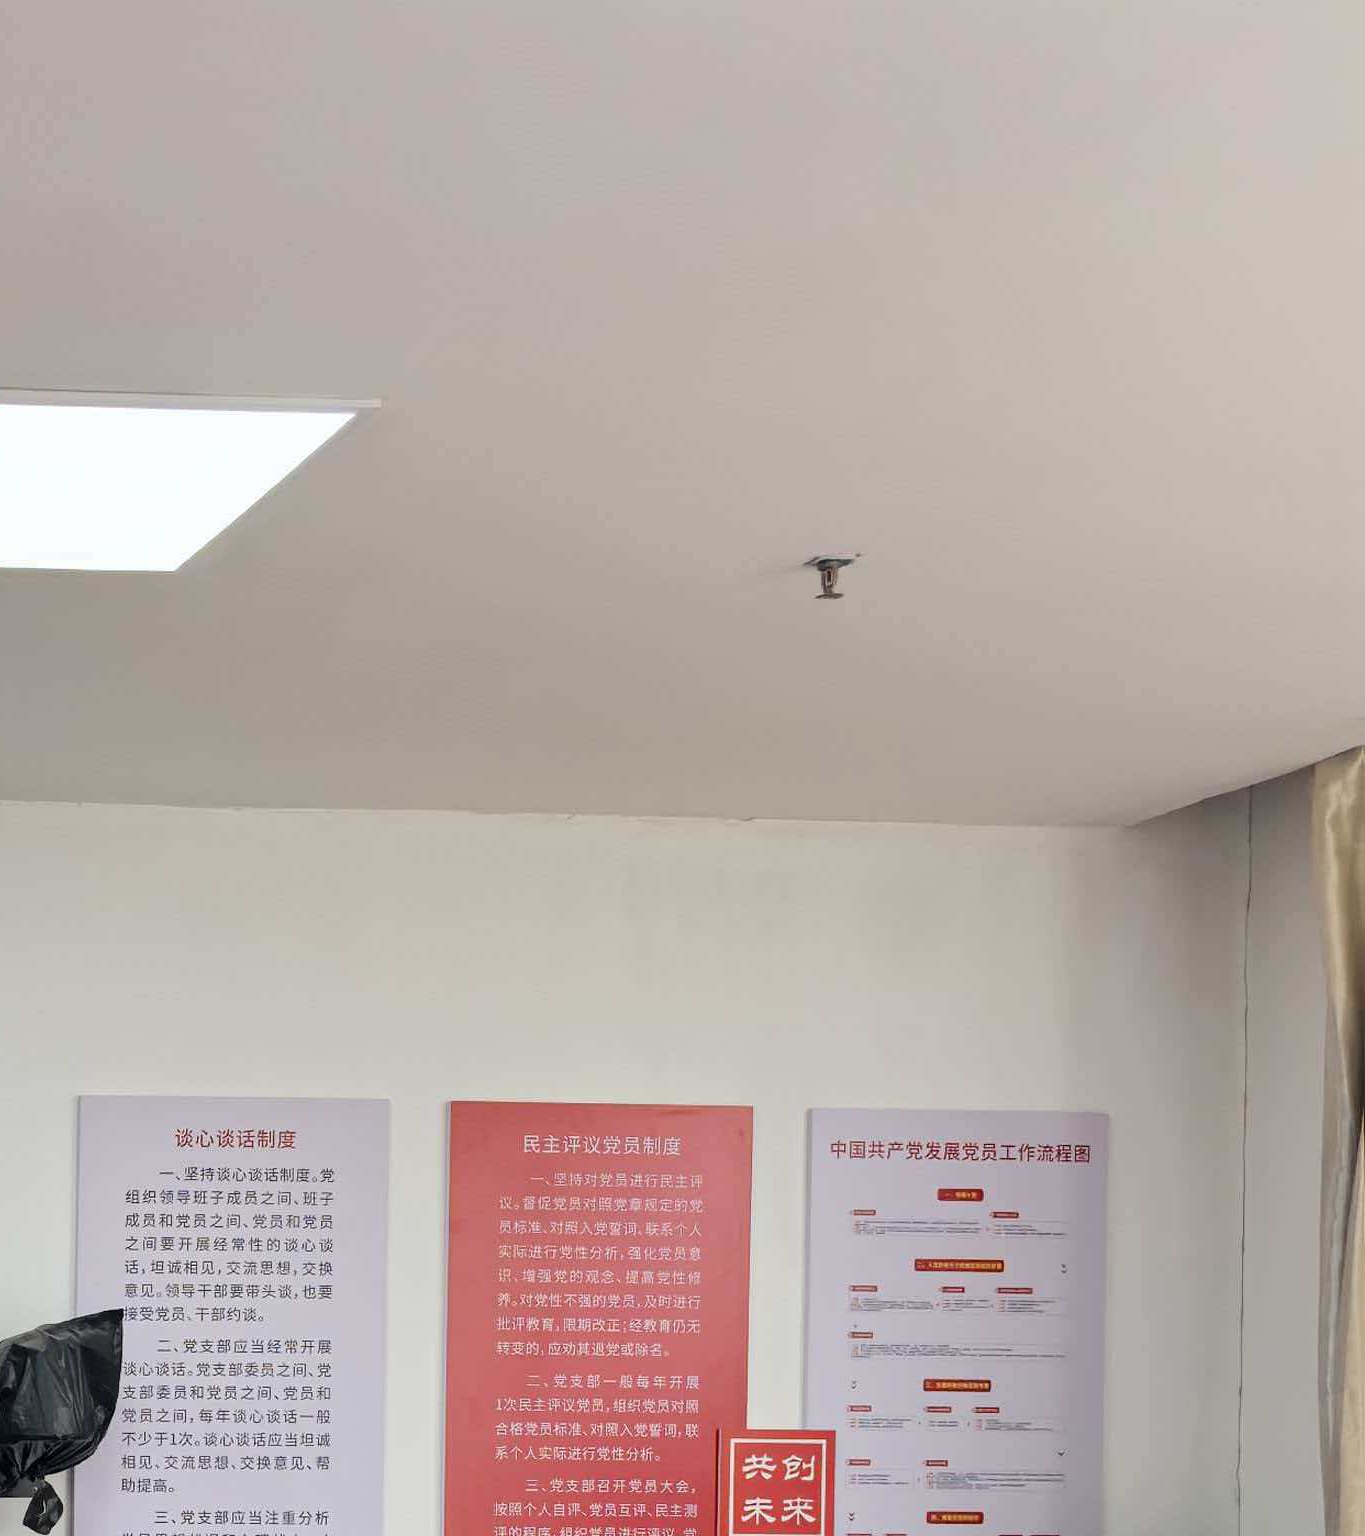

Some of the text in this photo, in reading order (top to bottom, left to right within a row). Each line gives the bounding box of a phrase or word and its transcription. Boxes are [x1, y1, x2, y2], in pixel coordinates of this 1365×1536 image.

[174, 1127, 297, 1150] 谈心谈话制度
[523, 1134, 681, 1156] 民主评议党员制度
[830, 1140, 1091, 1164] 中国共产党发展党员工作流程图
[741, 1453, 818, 1481] 共创
[740, 1496, 817, 1526] 未来
